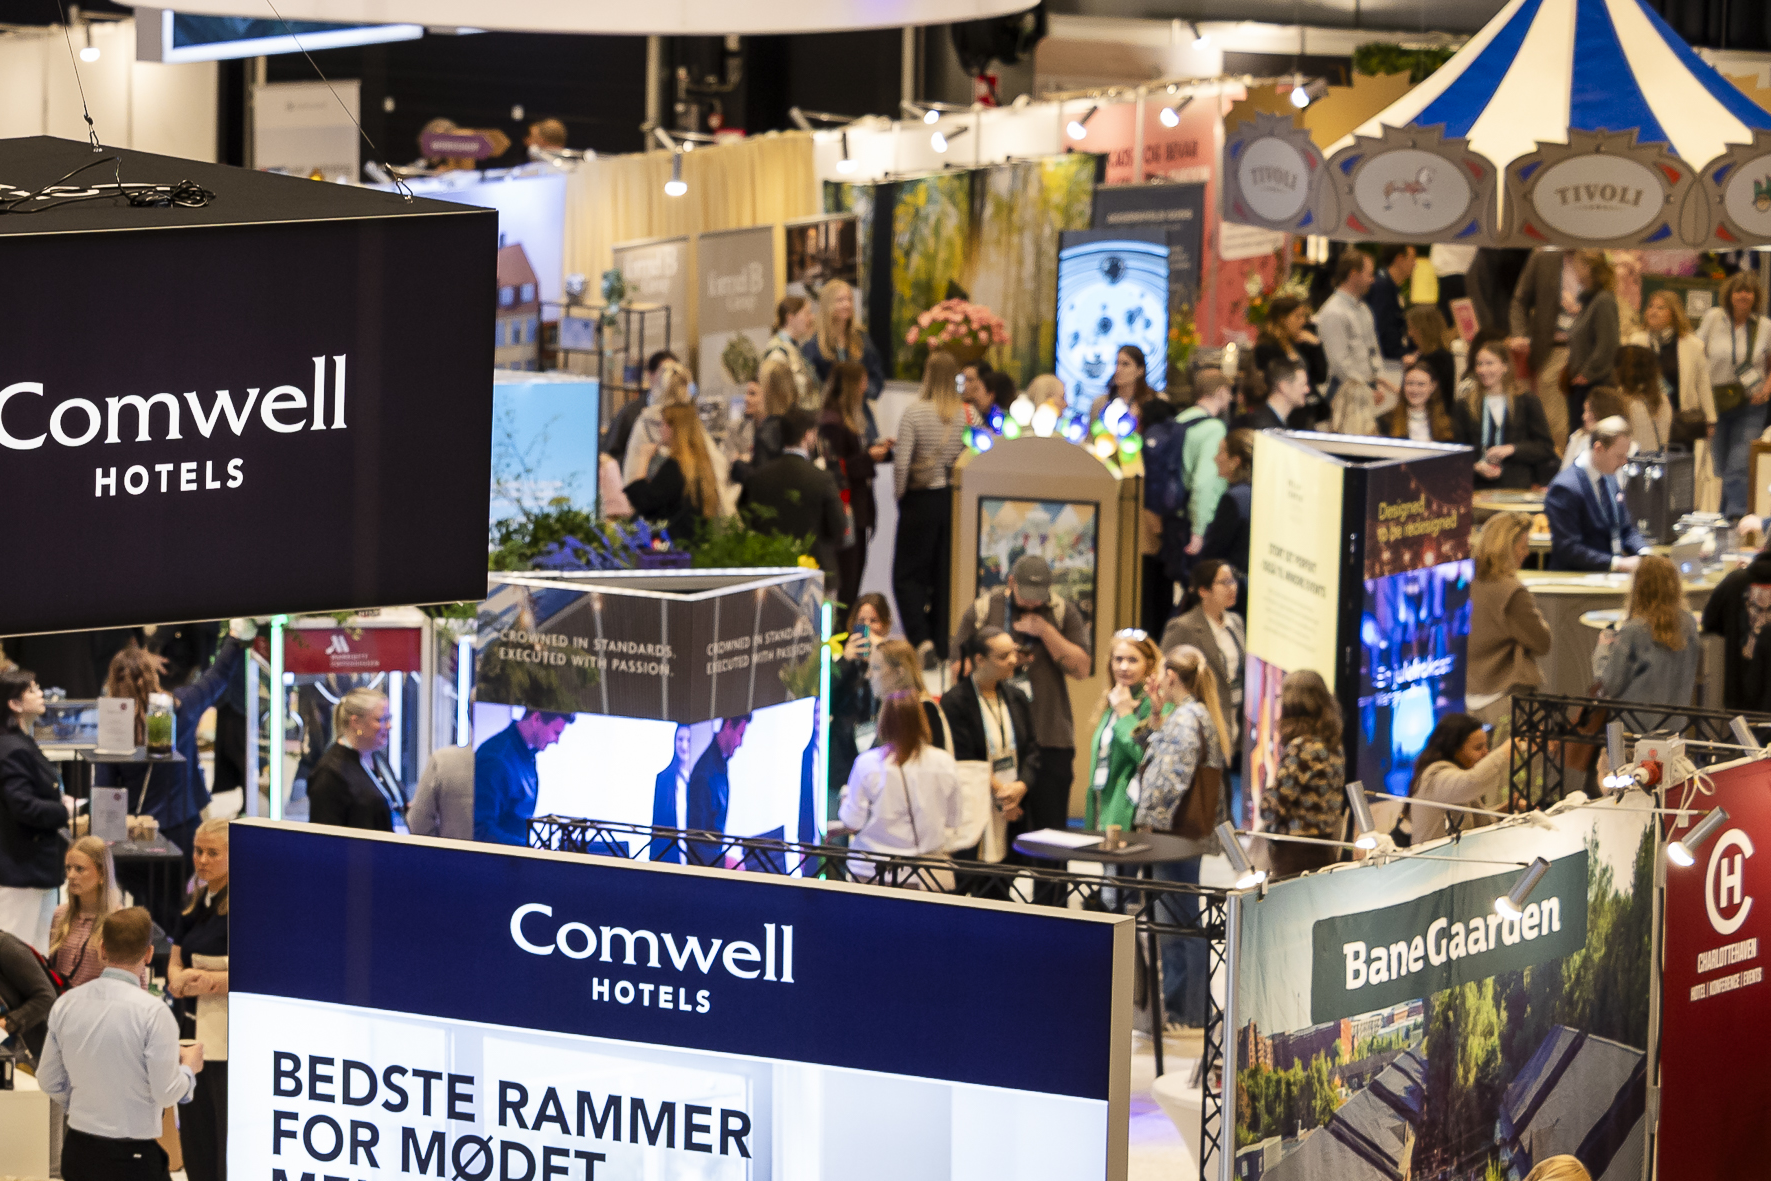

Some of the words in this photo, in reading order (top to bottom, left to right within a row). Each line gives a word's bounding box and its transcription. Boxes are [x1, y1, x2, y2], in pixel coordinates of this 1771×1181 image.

[1554, 182, 1644, 207] TIVOLI
[95, 457, 244, 497] HOTELS
[499, 630, 568, 648] CROWNED
[573, 636, 588, 649] IN
[499, 647, 566, 666] EXECUTED
[571, 655, 607, 669] WITH
[510, 903, 794, 983] Comwell
[1343, 896, 1561, 990] BaneGaarden
[592, 977, 710, 1013] HOTELS
[273, 1051, 475, 1122] BEDSTE
[498, 1080, 752, 1159] RAMMER
[273, 1110, 379, 1168] FOR
